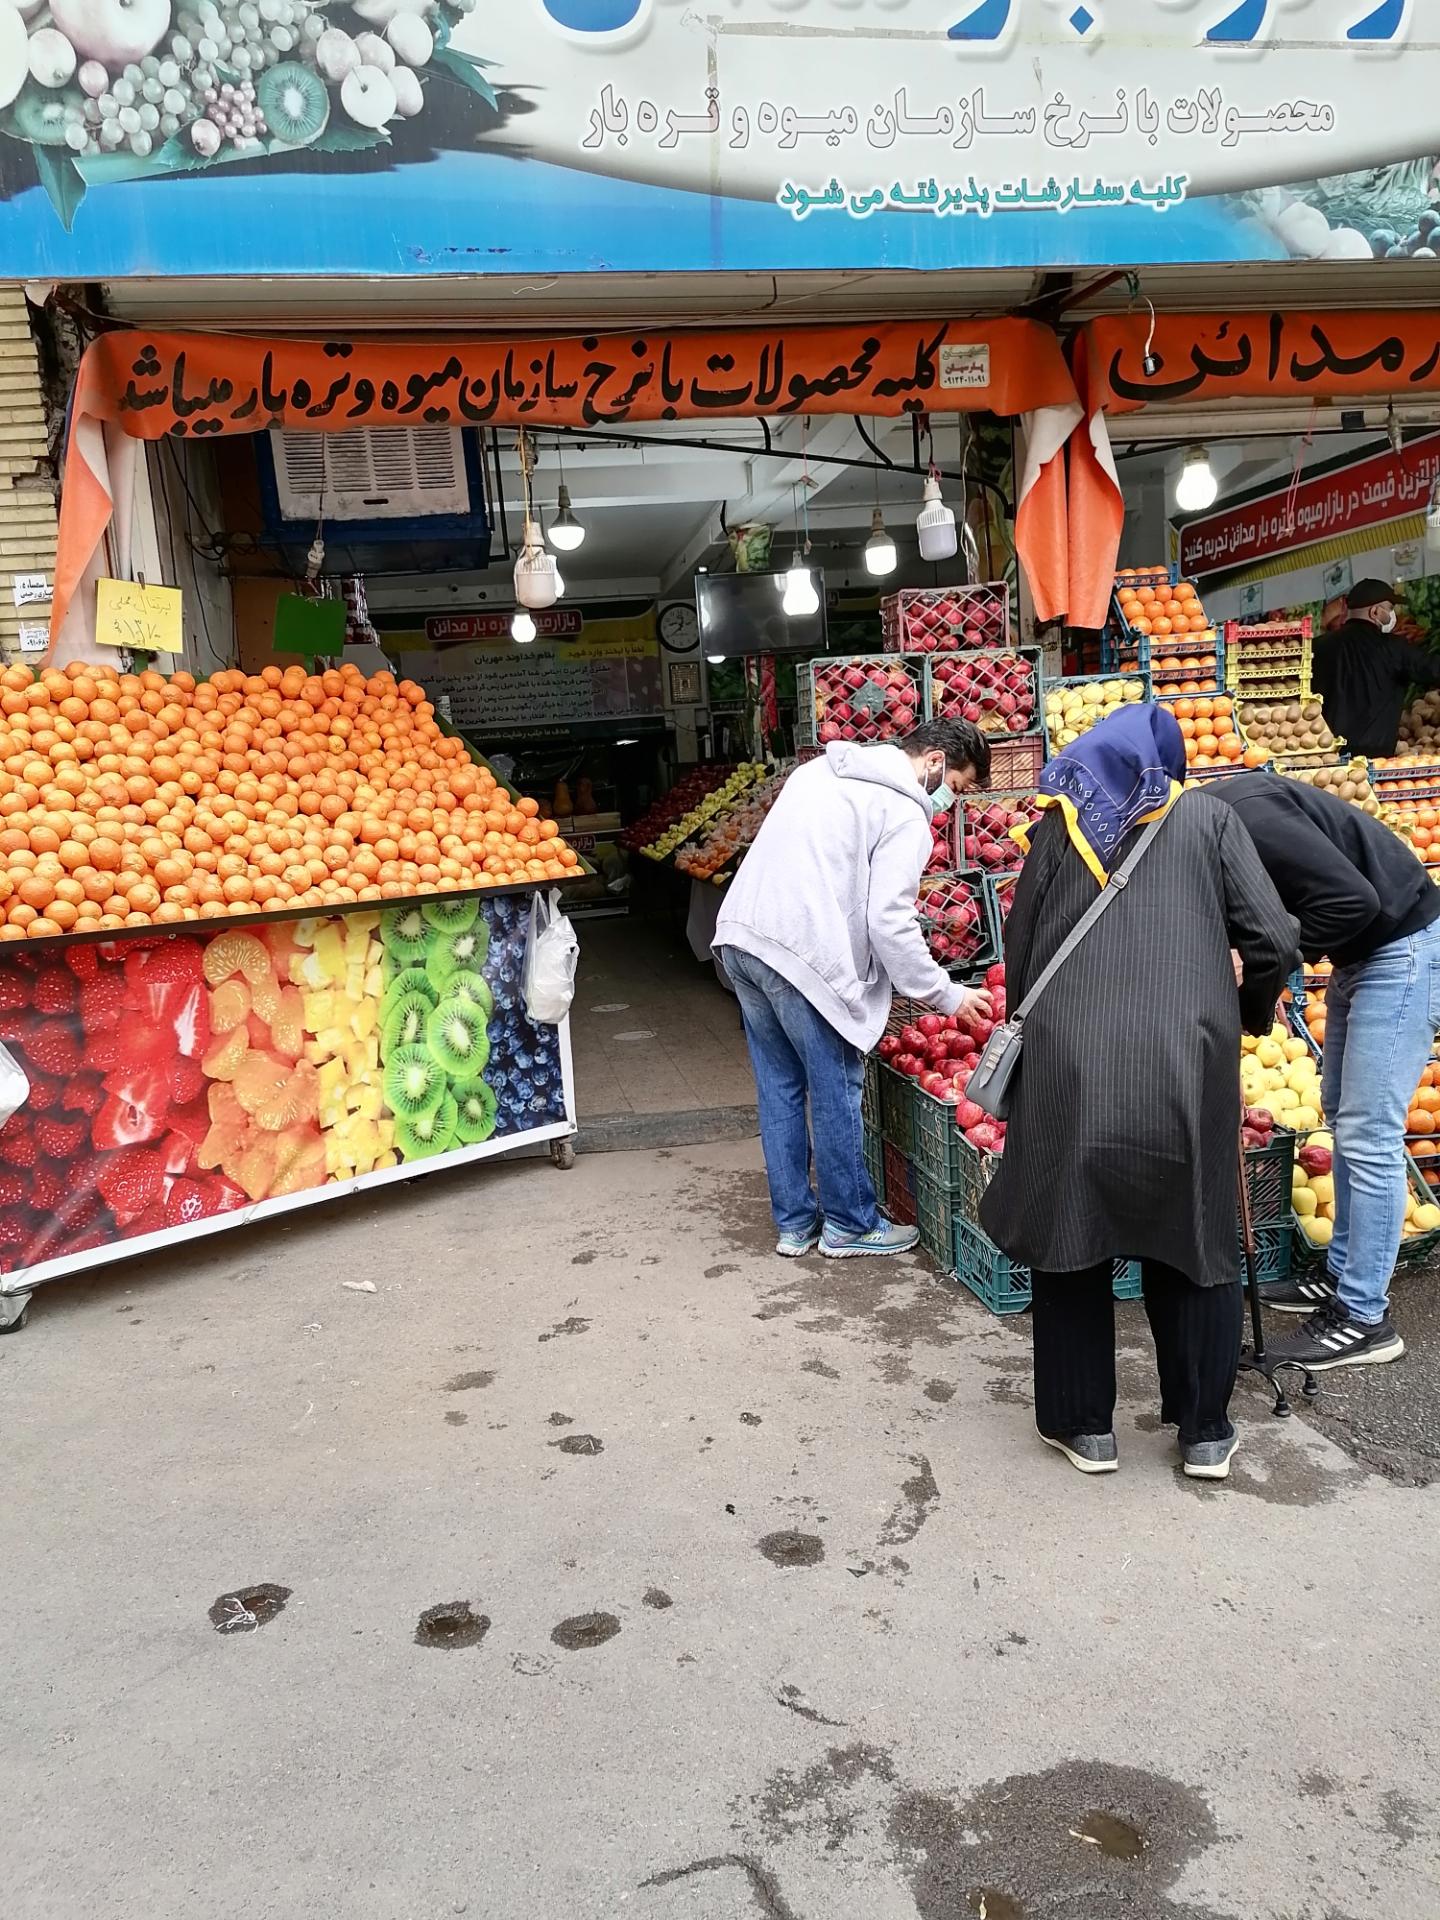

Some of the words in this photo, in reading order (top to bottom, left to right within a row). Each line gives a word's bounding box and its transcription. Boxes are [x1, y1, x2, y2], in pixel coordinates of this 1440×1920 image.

[582, 83, 628, 148] بار
[636, 87, 720, 149] تره
[729, 106, 750, 148] و
[757, 101, 857, 148] میوه
[866, 87, 1035, 149] سازمان
[1043, 87, 1128, 148] نرخ
[1136, 87, 1160, 147] با
[1167, 87, 1334, 147] محصولات
[781, 178, 844, 215] شود
[850, 188, 884, 214] می
[890, 177, 990, 213] پذیرفته
[995, 177, 1124, 209] سفارشات
[1130, 175, 1187, 208] کلیه
[689, 336, 882, 414] محصولات
[872, 322, 950, 413] کلیه
[1108, 311, 1406, 402] مدائن
[230, 349, 286, 431] بار
[380, 355, 464, 424] میوه
[457, 347, 578, 422] سازمان
[1361, 470, 1396, 508] قیمت
[1397, 454, 1440, 501] ازلترین
[1346, 490, 1360, 521] در
[1184, 536, 1204, 567] کنید
[1204, 527, 1229, 561] تجربه
[1229, 522, 1256, 553] مدائن
[1255, 514, 1269, 548] بار
[433, 618, 468, 637] مدائن
[471, 617, 487, 637] بار
